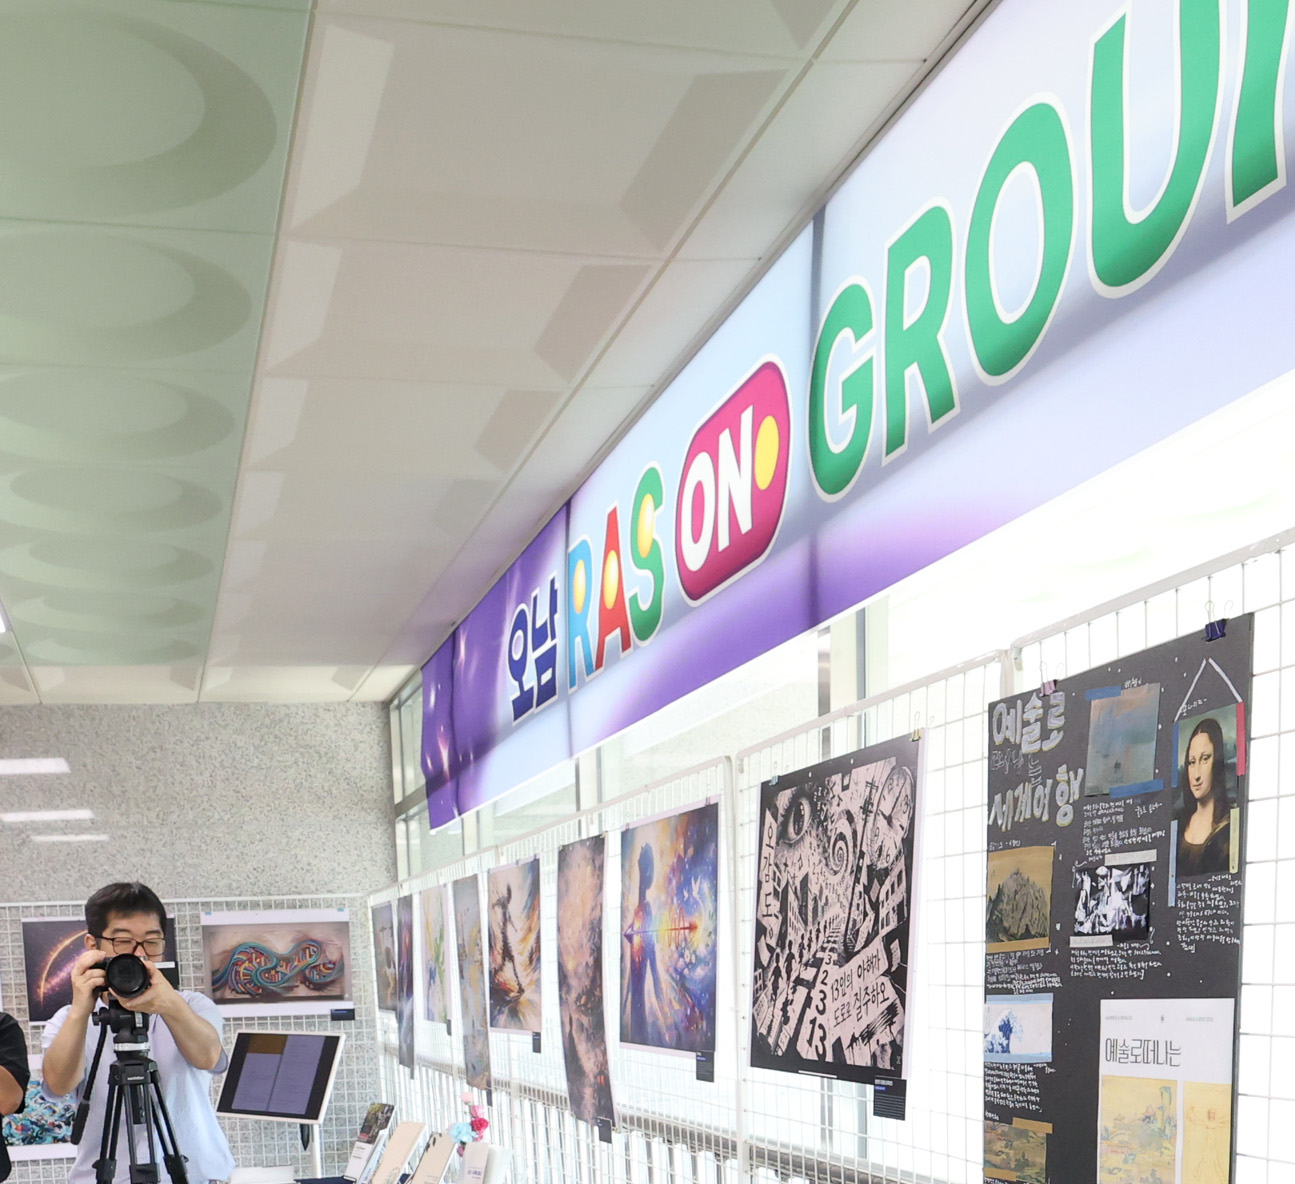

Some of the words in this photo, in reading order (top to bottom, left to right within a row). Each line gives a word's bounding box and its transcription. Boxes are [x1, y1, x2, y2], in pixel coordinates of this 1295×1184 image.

[568, 461, 665, 696] RAS
[676, 404, 753, 575] ON
[507, 573, 559, 723] 오남
[993, 692, 1065, 754] 예술로
[988, 764, 1084, 832] 세계여행
[762, 826, 774, 917] 오감도
[816, 989, 826, 1015] 3
[821, 970, 828, 985] 2
